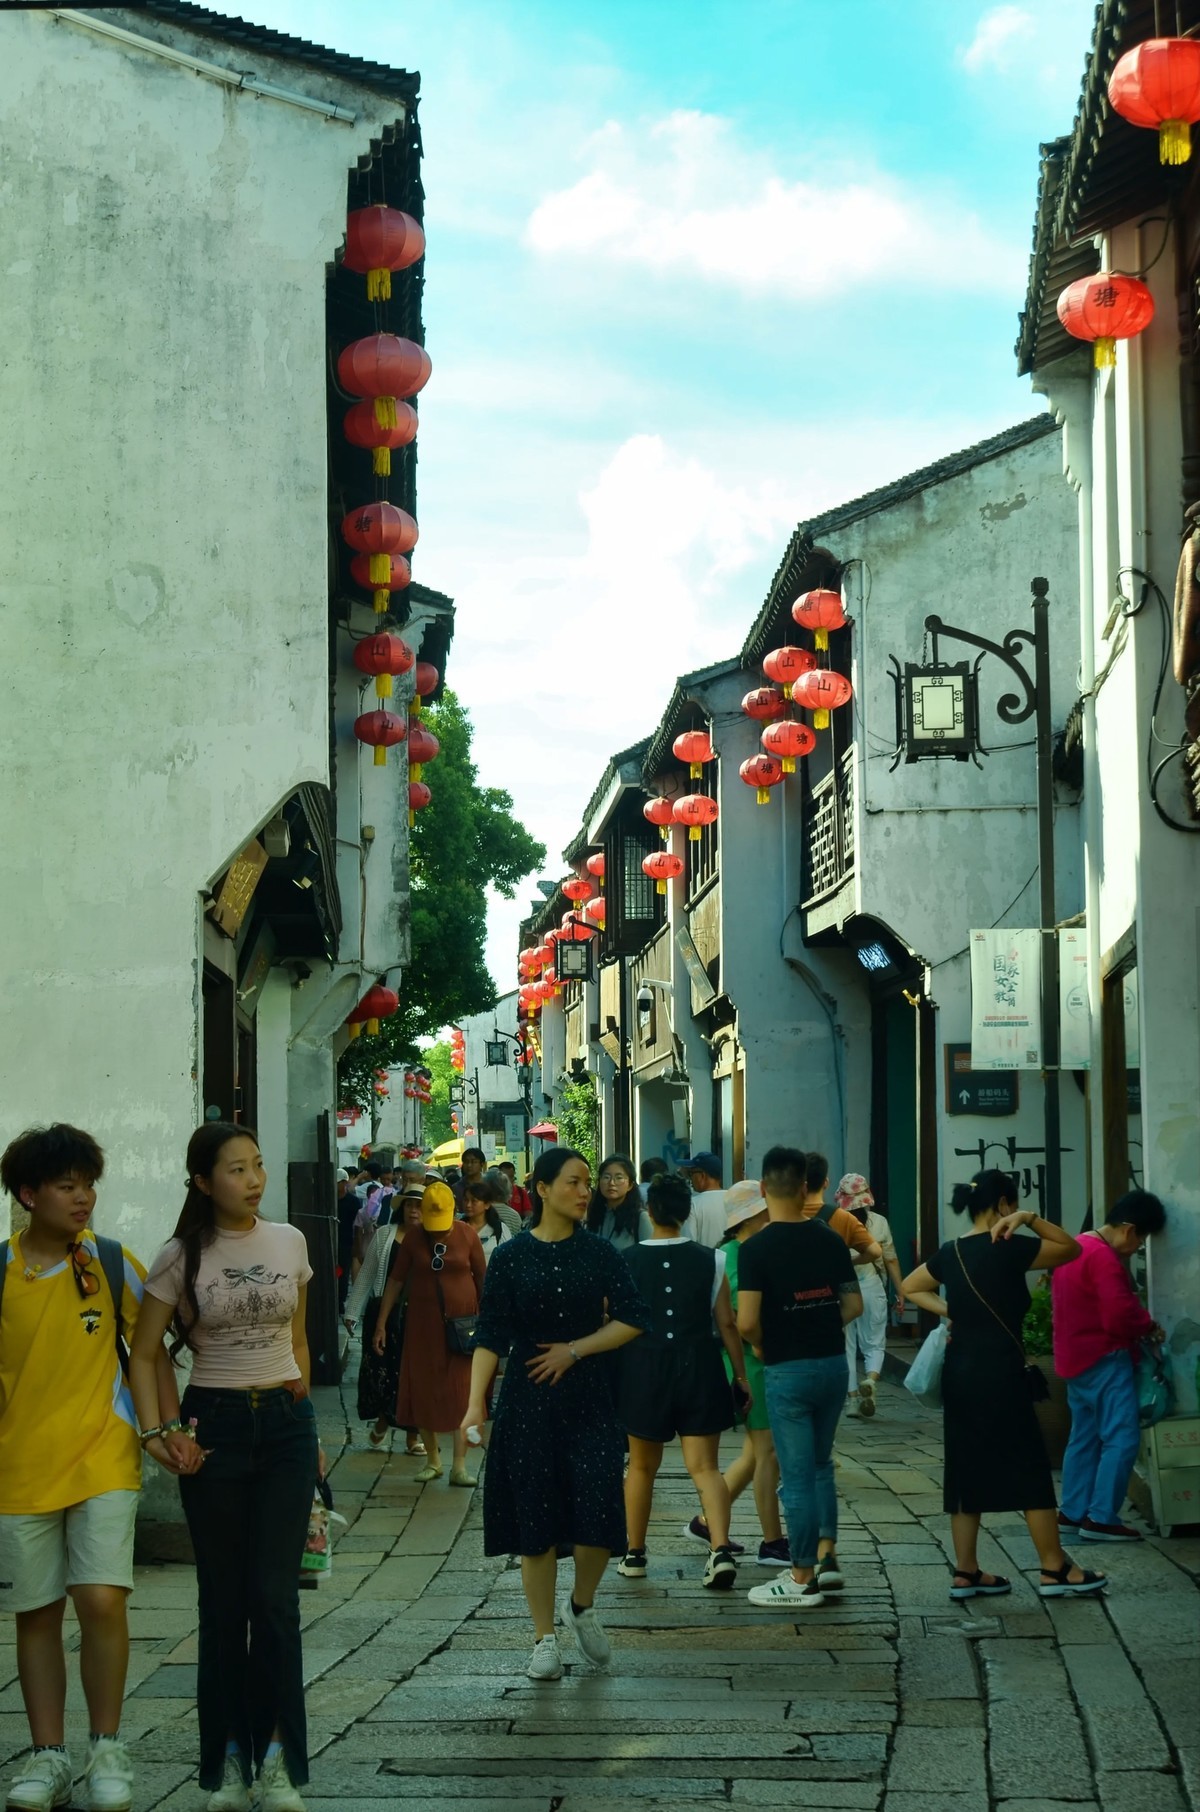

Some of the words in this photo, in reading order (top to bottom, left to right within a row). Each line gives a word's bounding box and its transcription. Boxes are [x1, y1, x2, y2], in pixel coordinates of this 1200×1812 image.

[1093, 286, 1120, 308] 塘
[781, 656, 795, 668] 山
[817, 678, 832, 692] 山
[770, 733, 782, 745] 山
[796, 732, 809, 746] 塘
[760, 762, 775, 775] 塘
